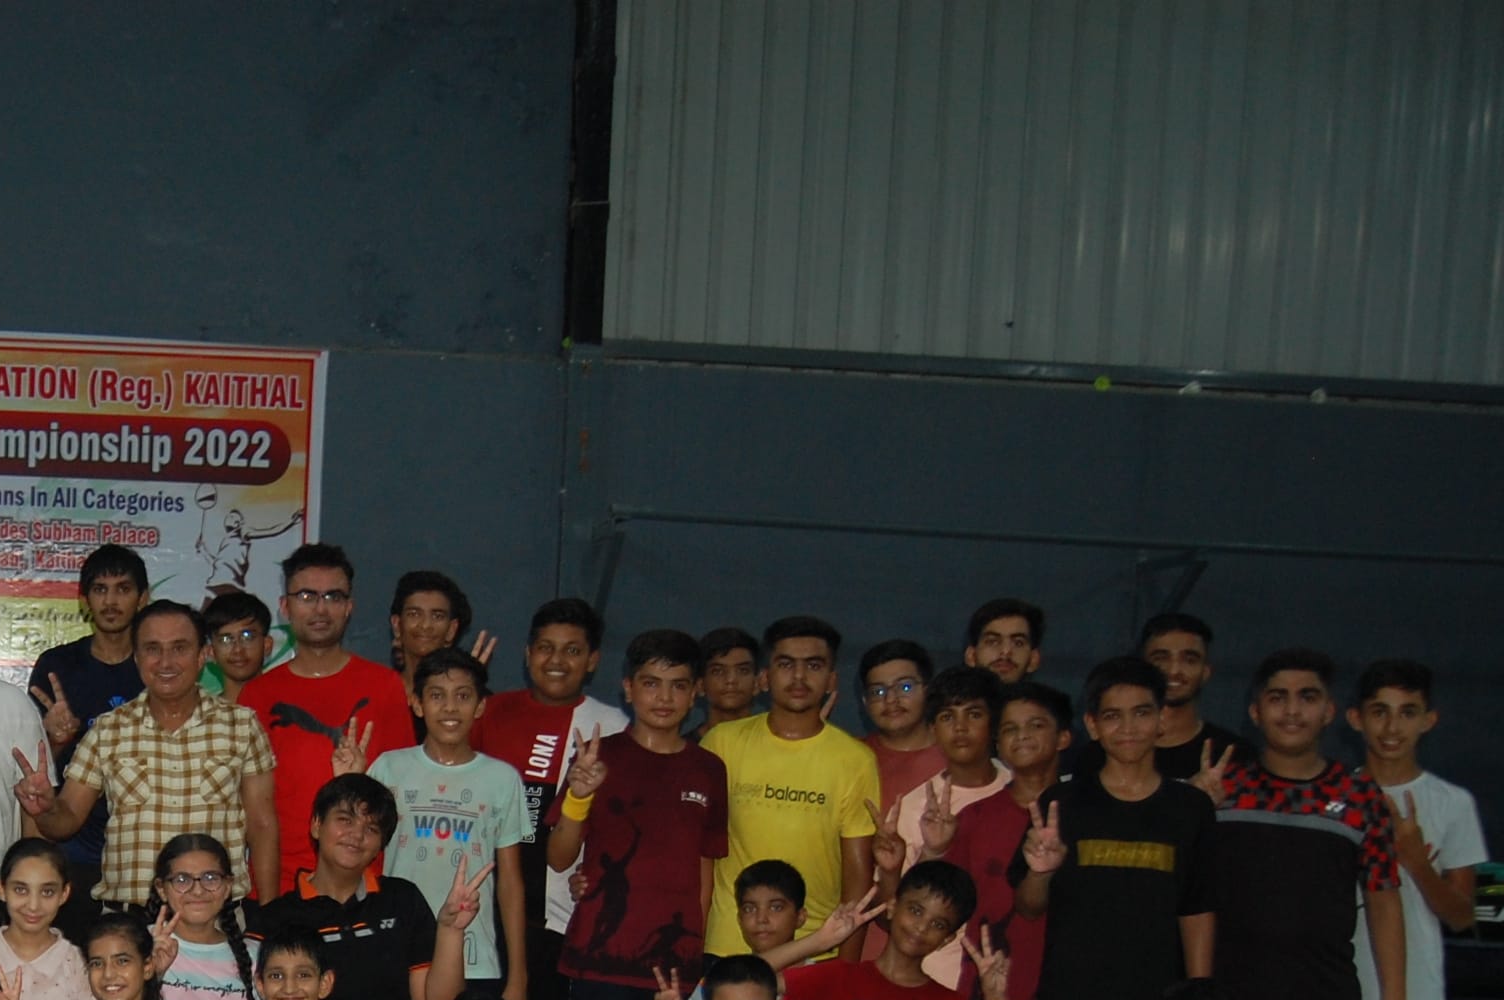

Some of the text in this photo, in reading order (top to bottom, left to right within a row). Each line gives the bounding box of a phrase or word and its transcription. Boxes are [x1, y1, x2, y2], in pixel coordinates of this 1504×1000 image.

[88, 369, 173, 411] (Reg.)
[184, 372, 303, 410] KAITHAL
[183, 427, 272, 469] 2022
[30, 486, 48, 507] In
[52, 487, 77, 509] All
[83, 487, 185, 515] Categories
[33, 521, 96, 542] Subham
[100, 524, 158, 545] Palace
[524, 733, 560, 779] LONA
[764, 784, 826, 805] balance
[414, 815, 474, 842] WOW
